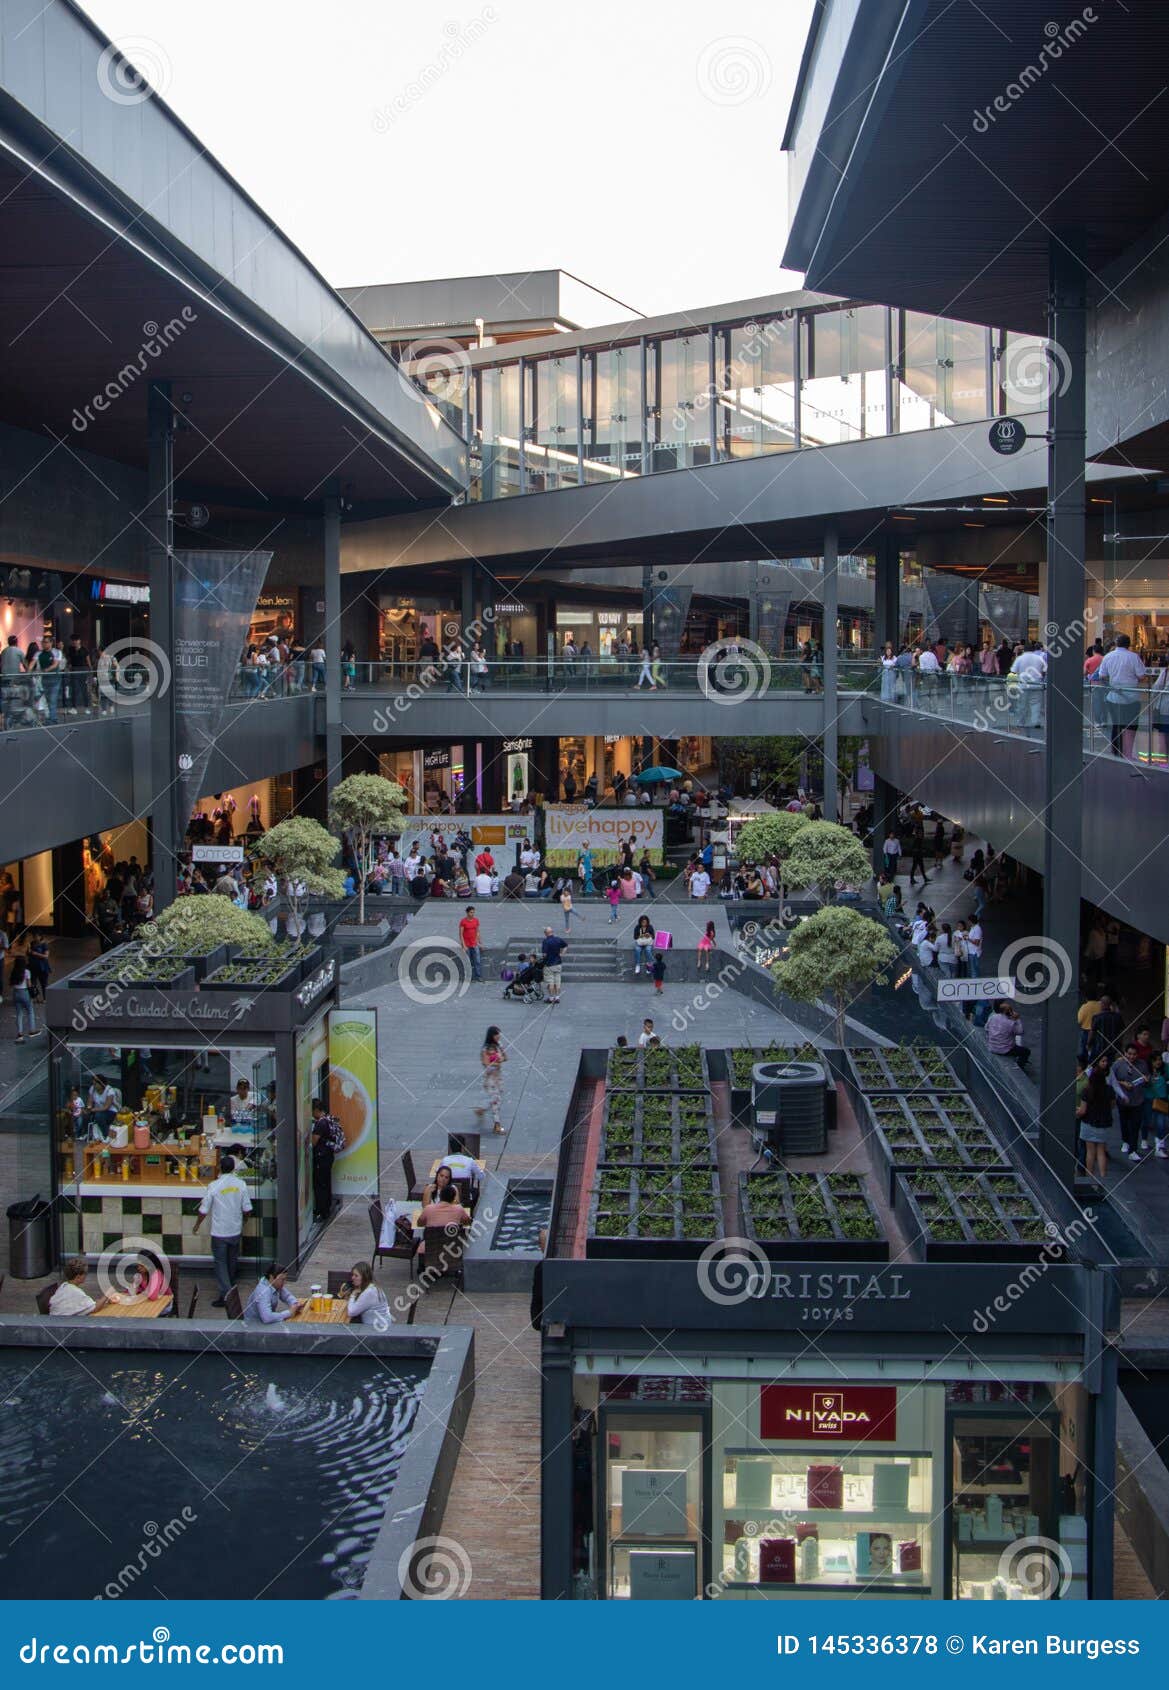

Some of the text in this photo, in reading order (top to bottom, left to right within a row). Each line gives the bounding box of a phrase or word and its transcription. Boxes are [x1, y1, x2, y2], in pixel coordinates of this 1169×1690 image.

[550, 815, 657, 840] livehappy
[941, 981, 1010, 997] antea
[127, 996, 168, 1017] Ciudad
[172, 1000, 186, 1018] de
[748, 1273, 911, 1299] CRISTAL
[802, 1308, 854, 1320] JOYAS
[785, 1409, 870, 1422] NIVADA
[818, 1421, 837, 1430] swiss
